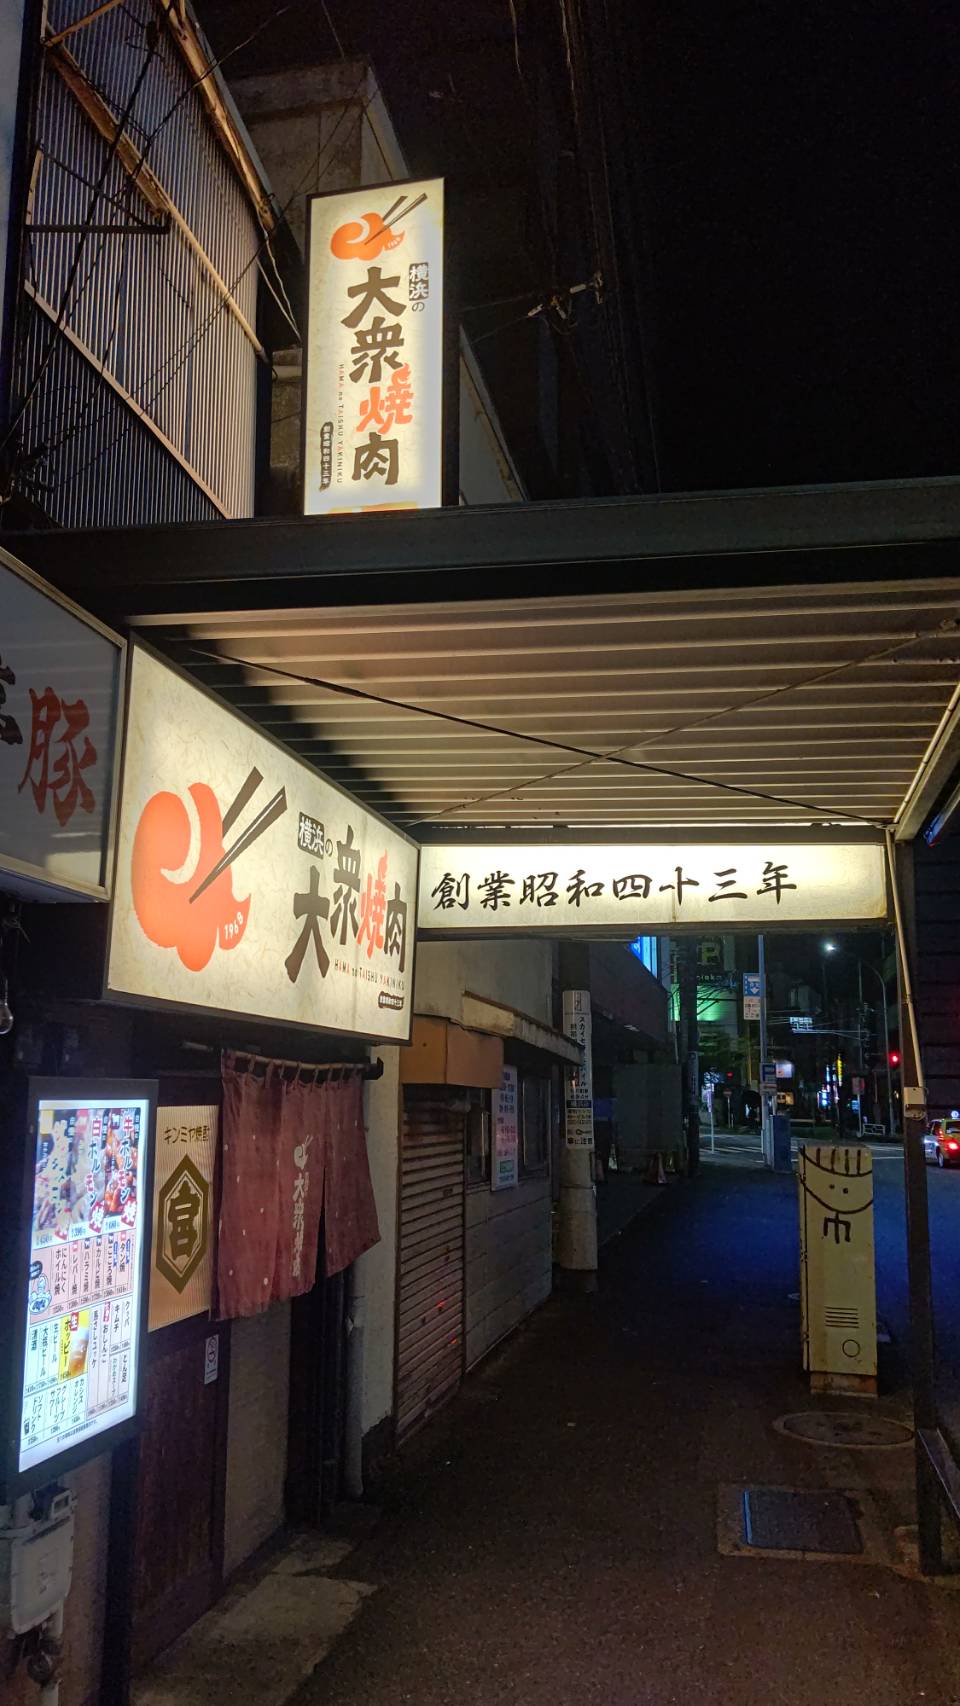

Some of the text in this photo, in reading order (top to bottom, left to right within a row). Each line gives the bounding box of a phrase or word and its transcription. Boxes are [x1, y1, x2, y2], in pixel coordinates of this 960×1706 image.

[409, 263, 429, 312] 横浜の
[341, 266, 414, 485] 大衆焼肉
[299, 814, 334, 859] 横浜の
[284, 825, 408, 983] 大衆焼肉
[431, 861, 798, 911] 創業昭和四十三年
[224, 911, 244, 941] 1968
